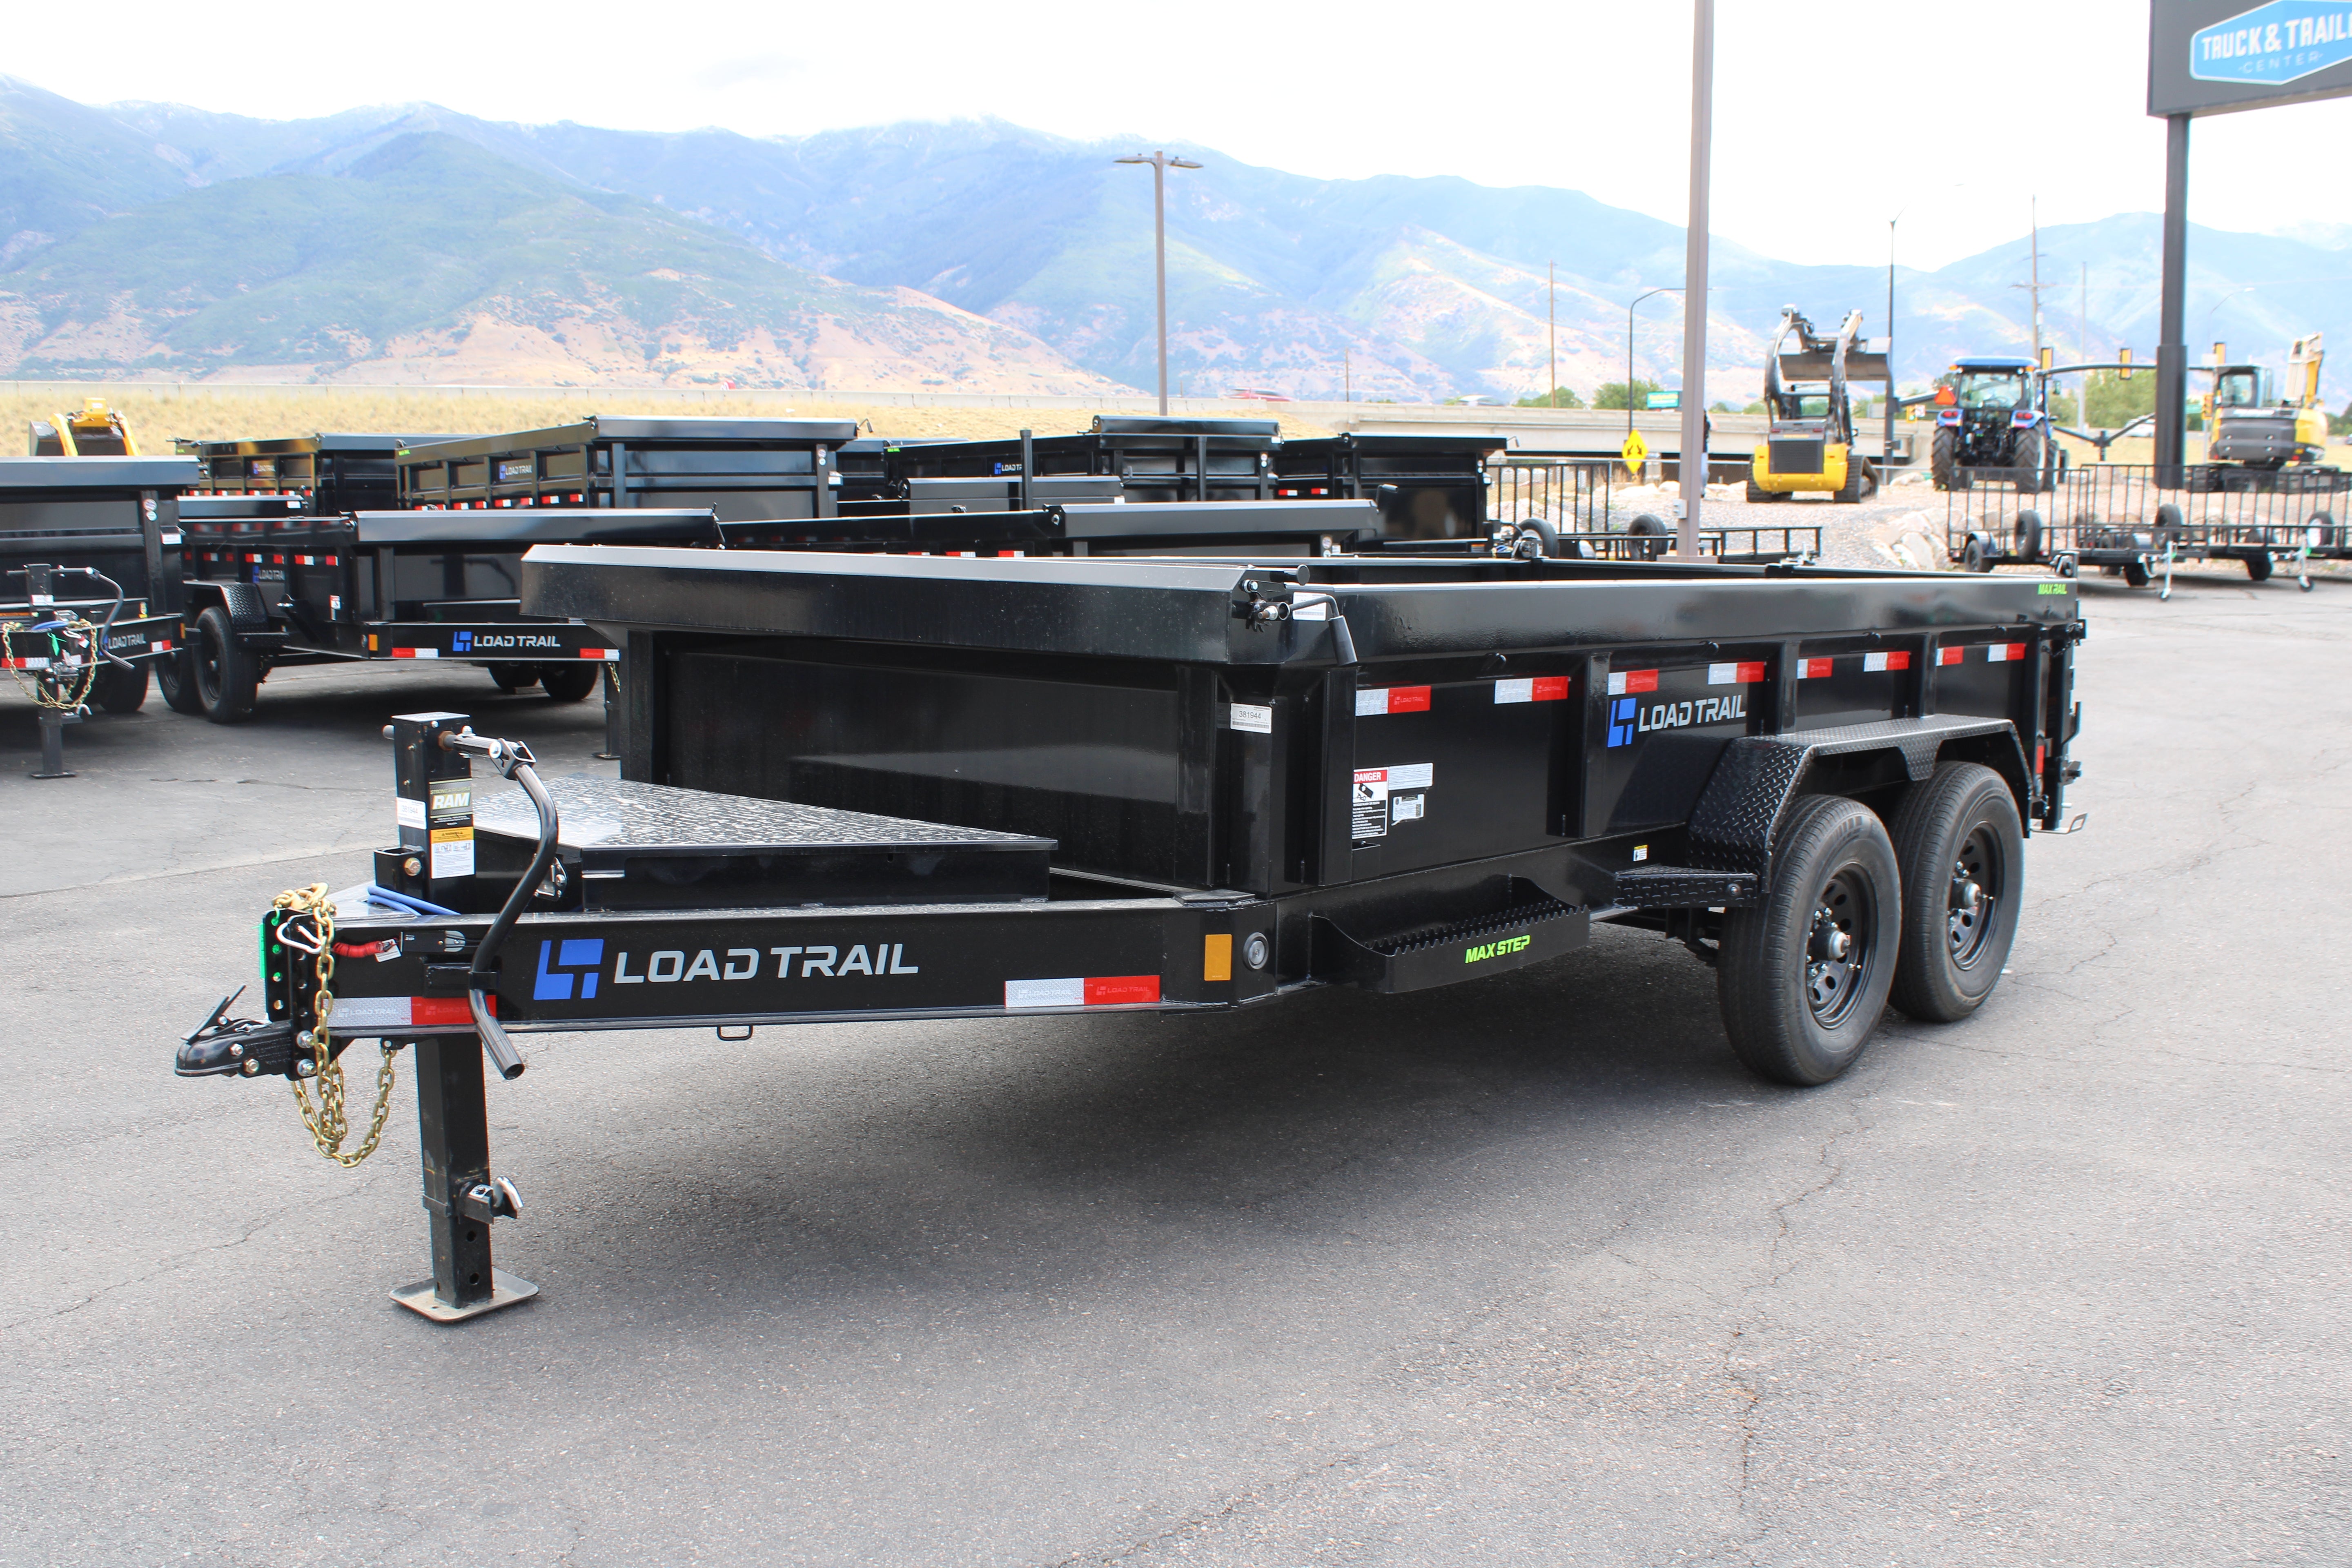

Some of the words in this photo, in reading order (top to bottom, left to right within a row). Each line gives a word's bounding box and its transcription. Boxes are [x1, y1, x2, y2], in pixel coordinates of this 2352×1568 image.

[2201, 27, 2263, 61] TRUCK
[2265, 23, 2282, 52] &
[2243, 51, 2320, 74] CENTER
[2038, 584, 2053, 595] MAX
[2053, 584, 2067, 595] RAIL
[108, 636, 127, 650] LOAD
[127, 633, 147, 646] TRAIL
[473, 635, 514, 647] LOAD
[517, 635, 561, 647] TRAIL
[1239, 710, 1261, 719] 381944
[1638, 701, 1693, 732] LOAD
[1695, 695, 1747, 724] TRAIL
[1354, 772, 1381, 782] DANGER
[432, 792, 471, 810] RAM
[1465, 943, 1497, 964] MAX
[1496, 934, 1531, 956] STEP
[614, 948, 760, 984] LOAD
[770, 943, 919, 978] TRAIL
